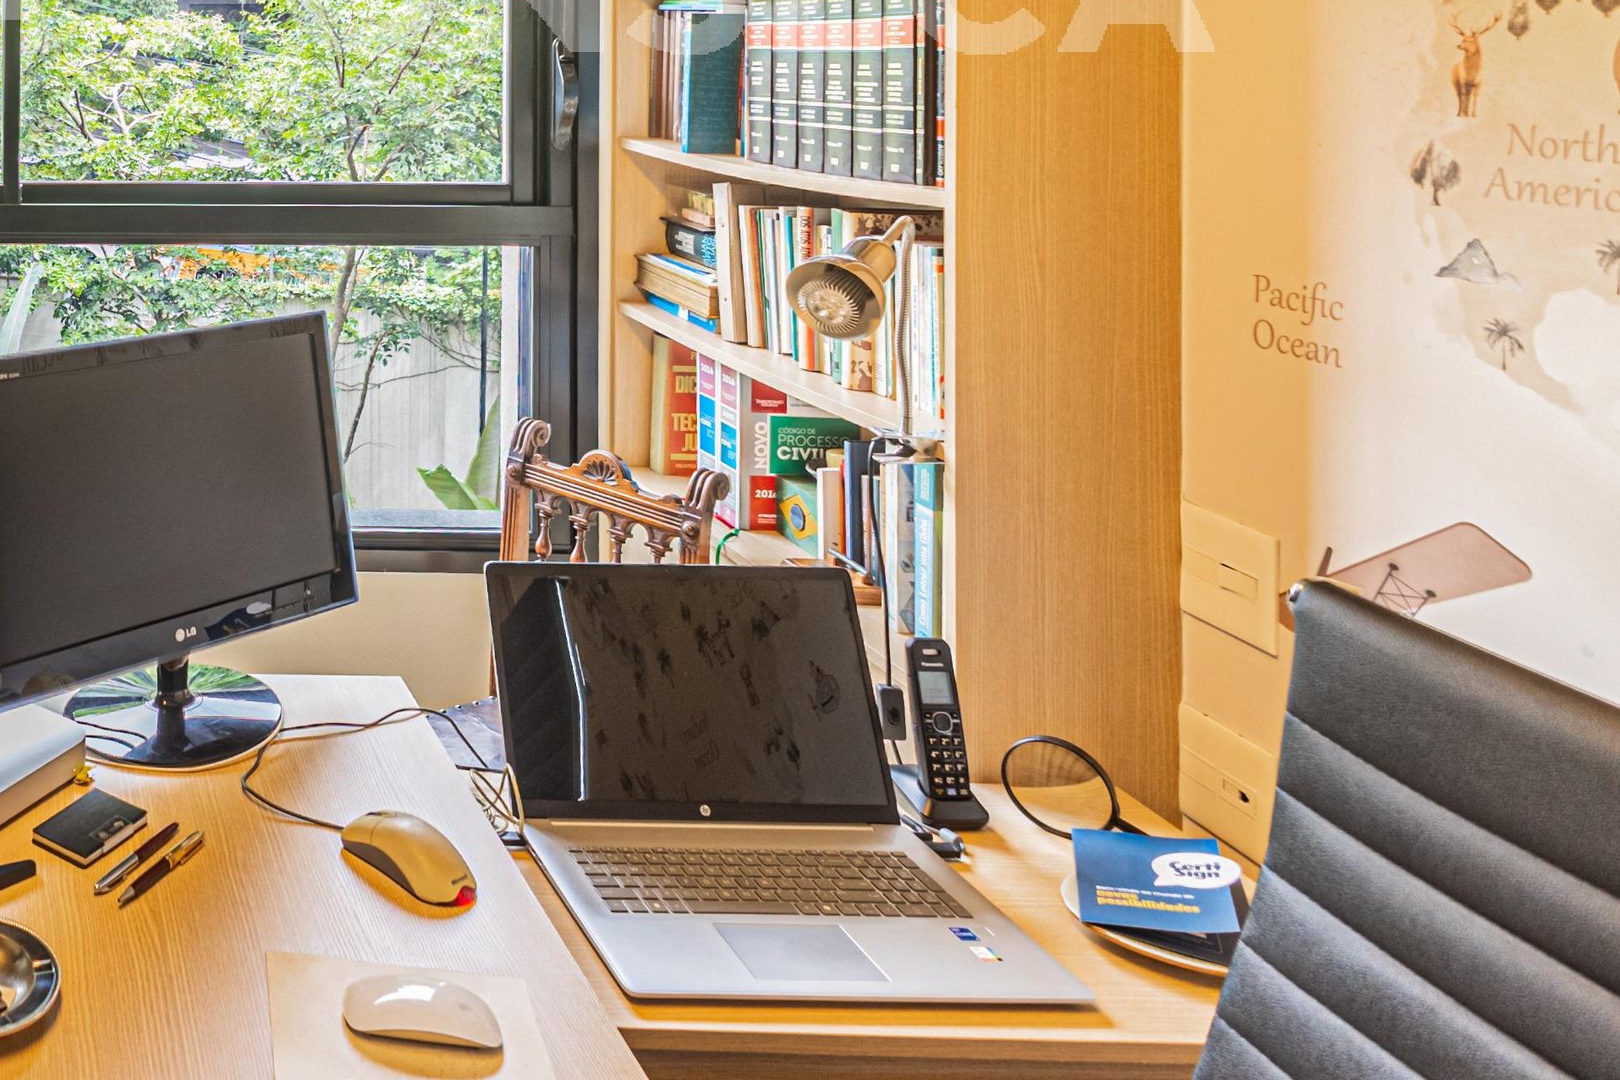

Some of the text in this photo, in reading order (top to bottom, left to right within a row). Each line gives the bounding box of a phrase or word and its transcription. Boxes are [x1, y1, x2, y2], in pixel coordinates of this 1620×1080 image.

[1507, 122, 1620, 165] North
[1483, 166, 1620, 213] Americ
[1253, 273, 1344, 325] Pacific
[1253, 319, 1343, 369] Ocean
[777, 426, 816, 435] CÓDIGO DE
[754, 421, 768, 469] NOVO
[777, 435, 850, 447] PROCESSO
[186, 627, 197, 638] LG
[1169, 861, 1221, 873] Certi
[1174, 869, 1221, 880] Sign
[1097, 896, 1201, 914] possibilidades
